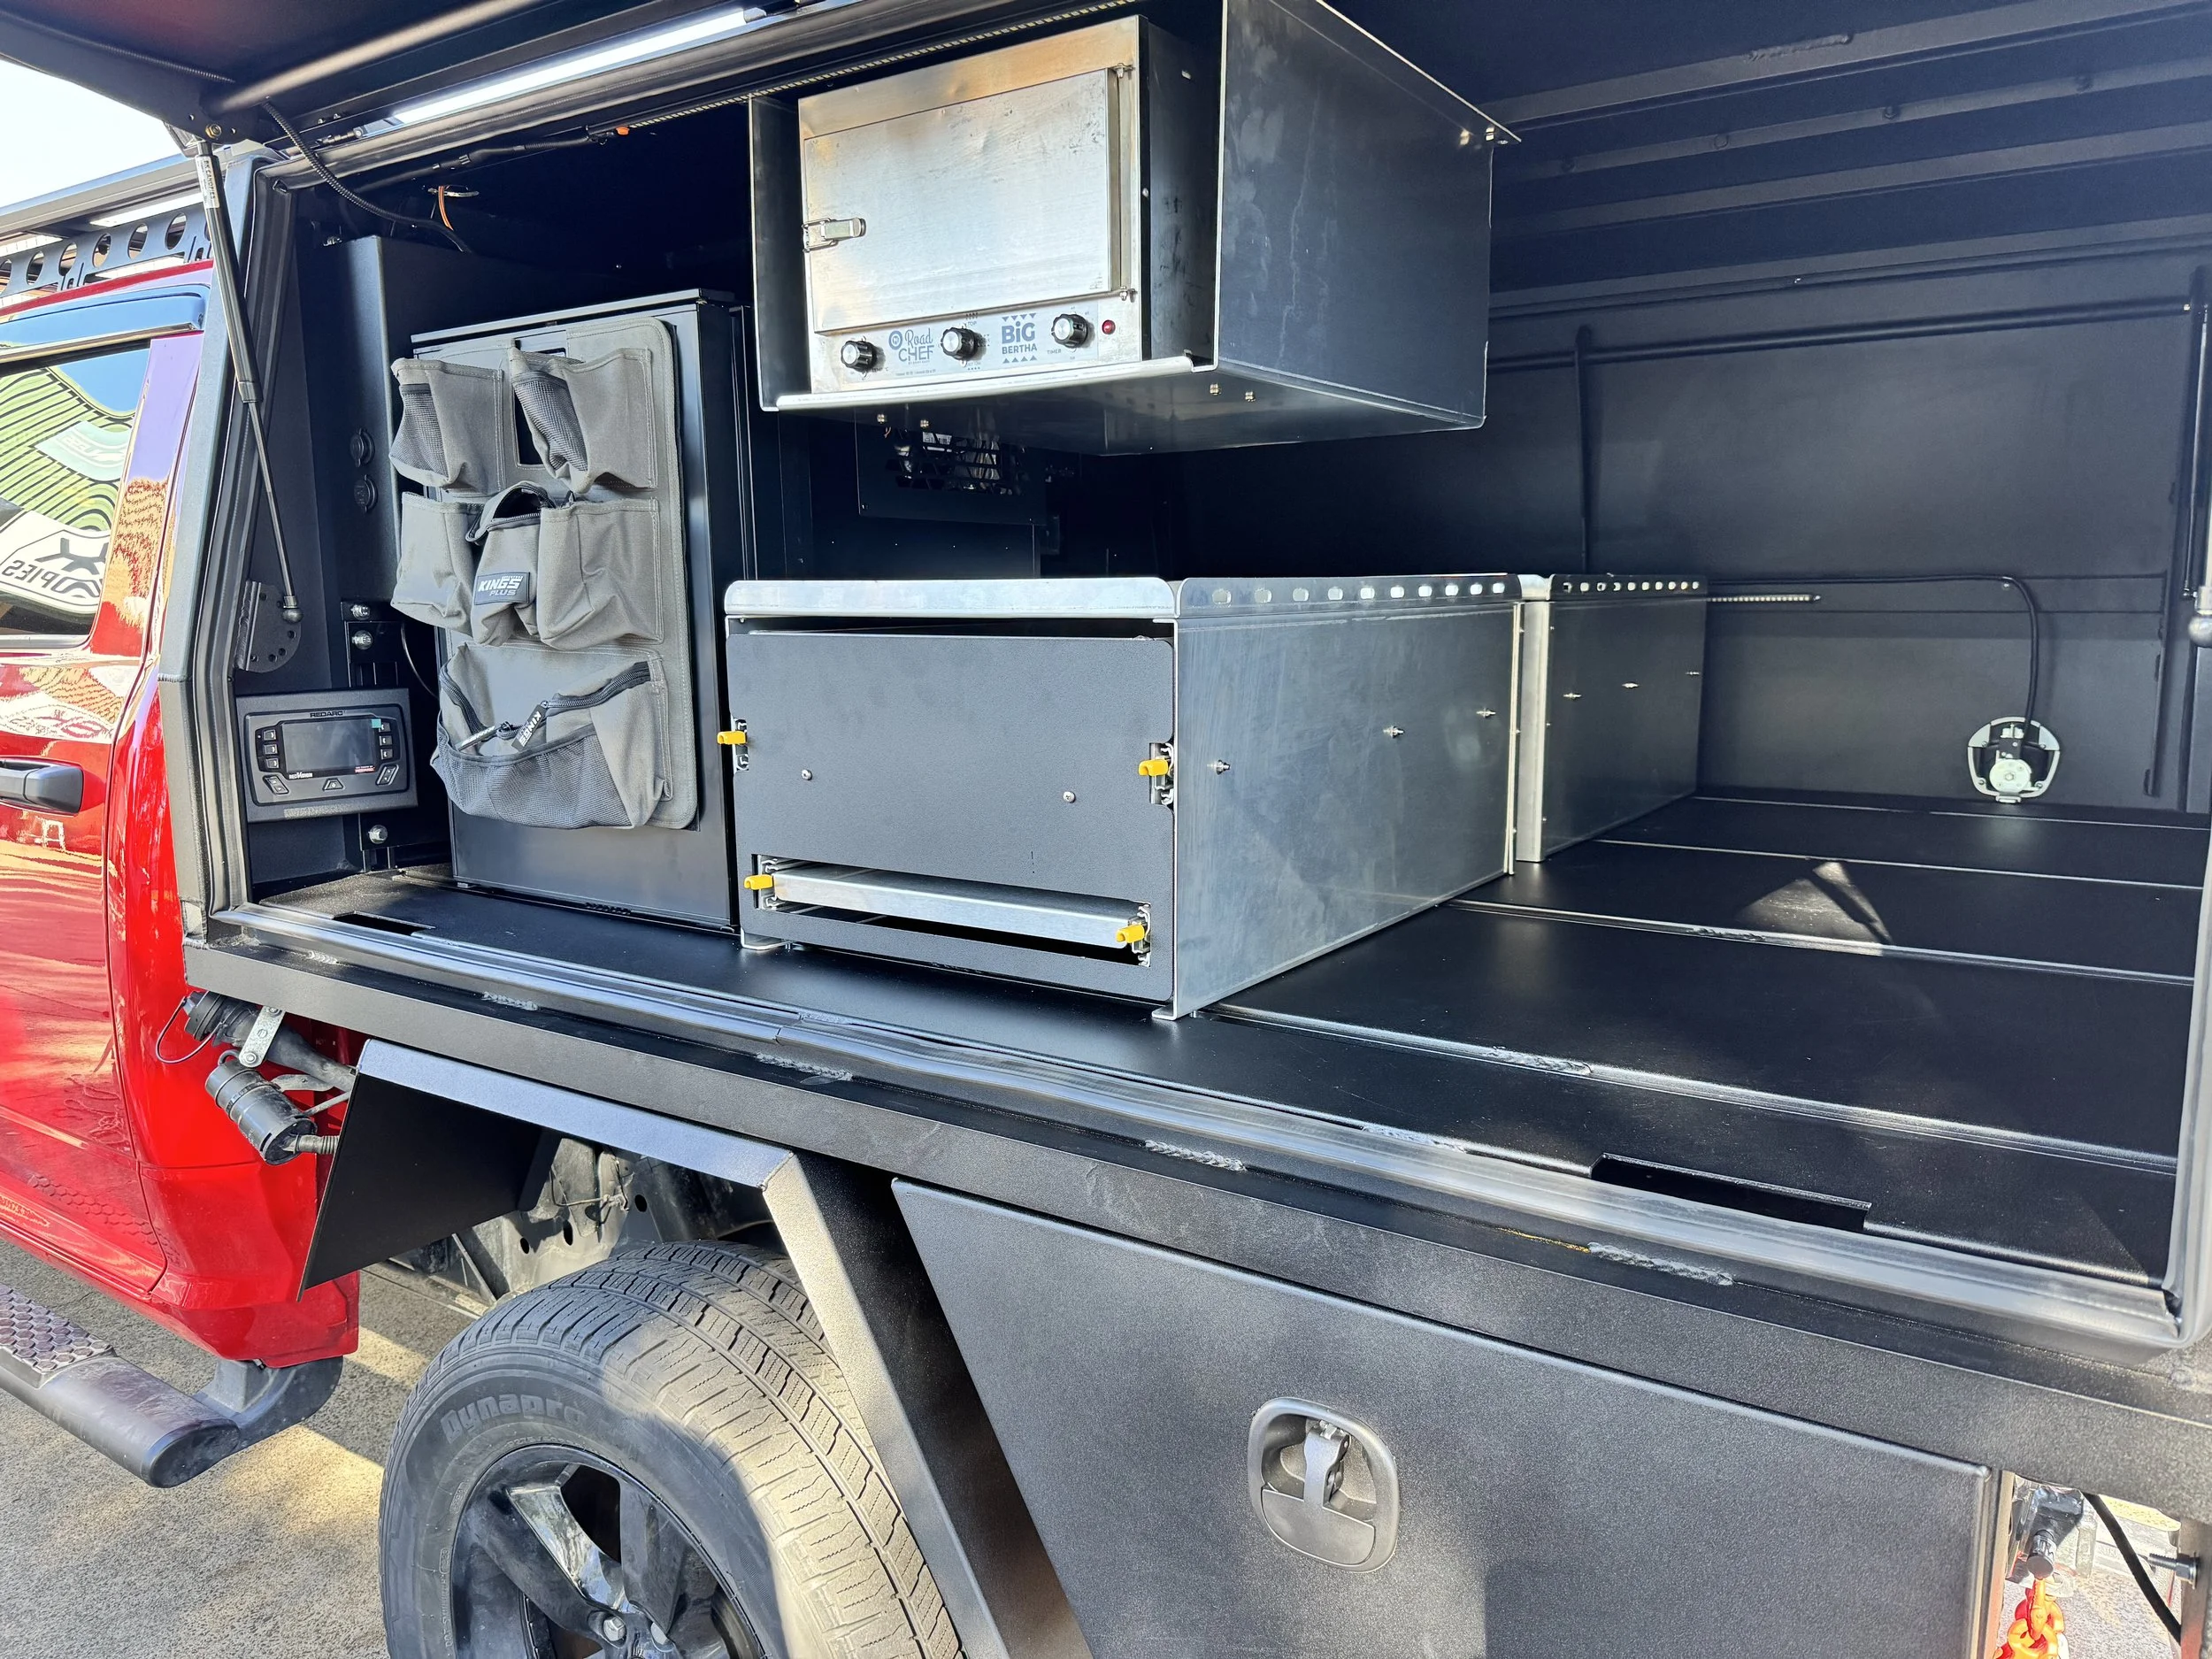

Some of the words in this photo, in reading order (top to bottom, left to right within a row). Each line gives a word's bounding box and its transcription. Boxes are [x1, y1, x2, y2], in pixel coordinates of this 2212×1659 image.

[205, 171, 216, 199] CANOPIES
[904, 327, 933, 349] Road
[1002, 321, 1035, 344] BiG
[898, 345, 934, 362] CHEF
[1002, 343, 1038, 355] BERTHA
[478, 575, 524, 592] KINGS
[518, 710, 541, 748] KINGS
